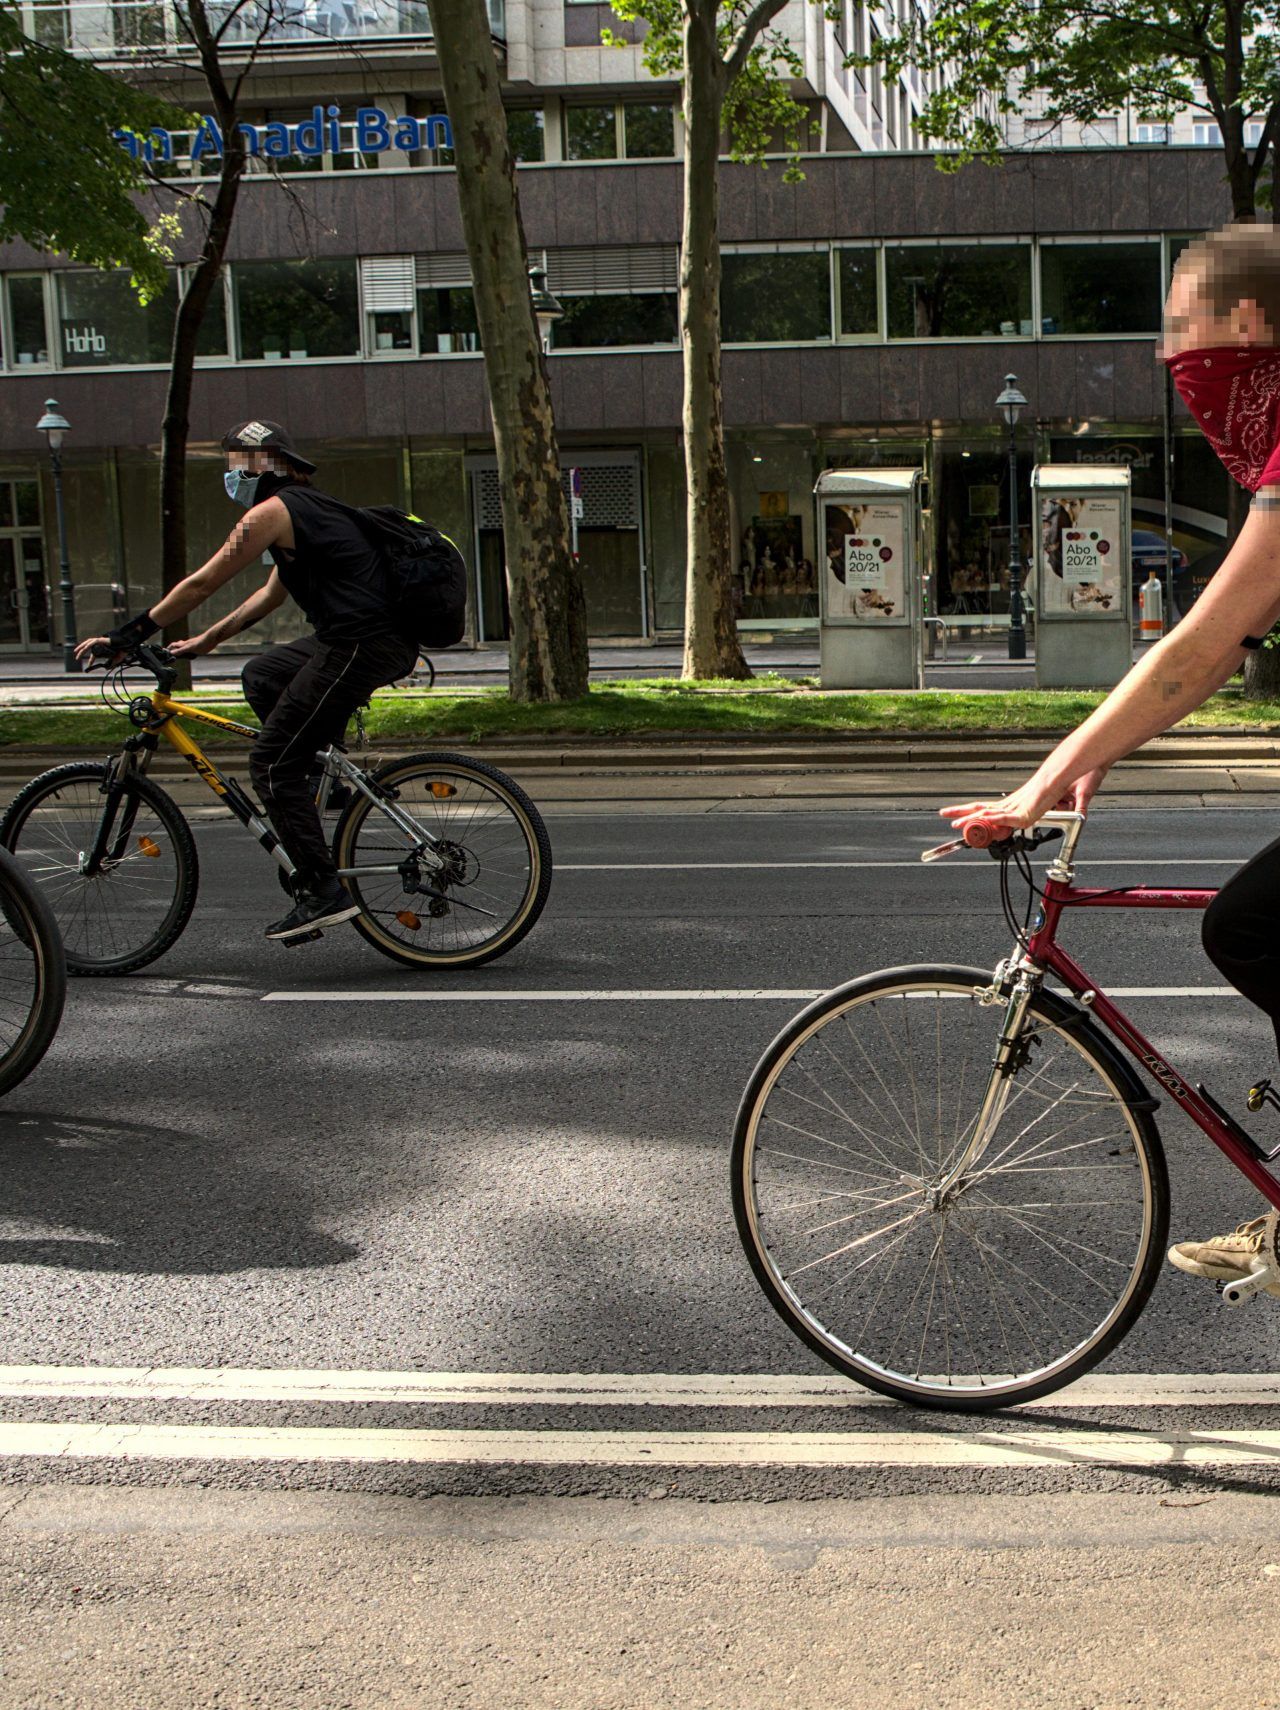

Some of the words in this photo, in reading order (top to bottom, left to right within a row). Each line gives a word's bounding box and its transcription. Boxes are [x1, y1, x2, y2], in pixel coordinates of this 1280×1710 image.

[191, 105, 342, 160] Anadi
[356, 106, 457, 154] Ban
[1066, 544, 1091, 555] Abo
[849, 550, 873, 561] Abo
[1066, 556, 1097, 566] 20/21
[849, 562, 880, 573] 20/21
[185, 752, 230, 796] KTM
[1142, 1053, 1188, 1099] KTM
